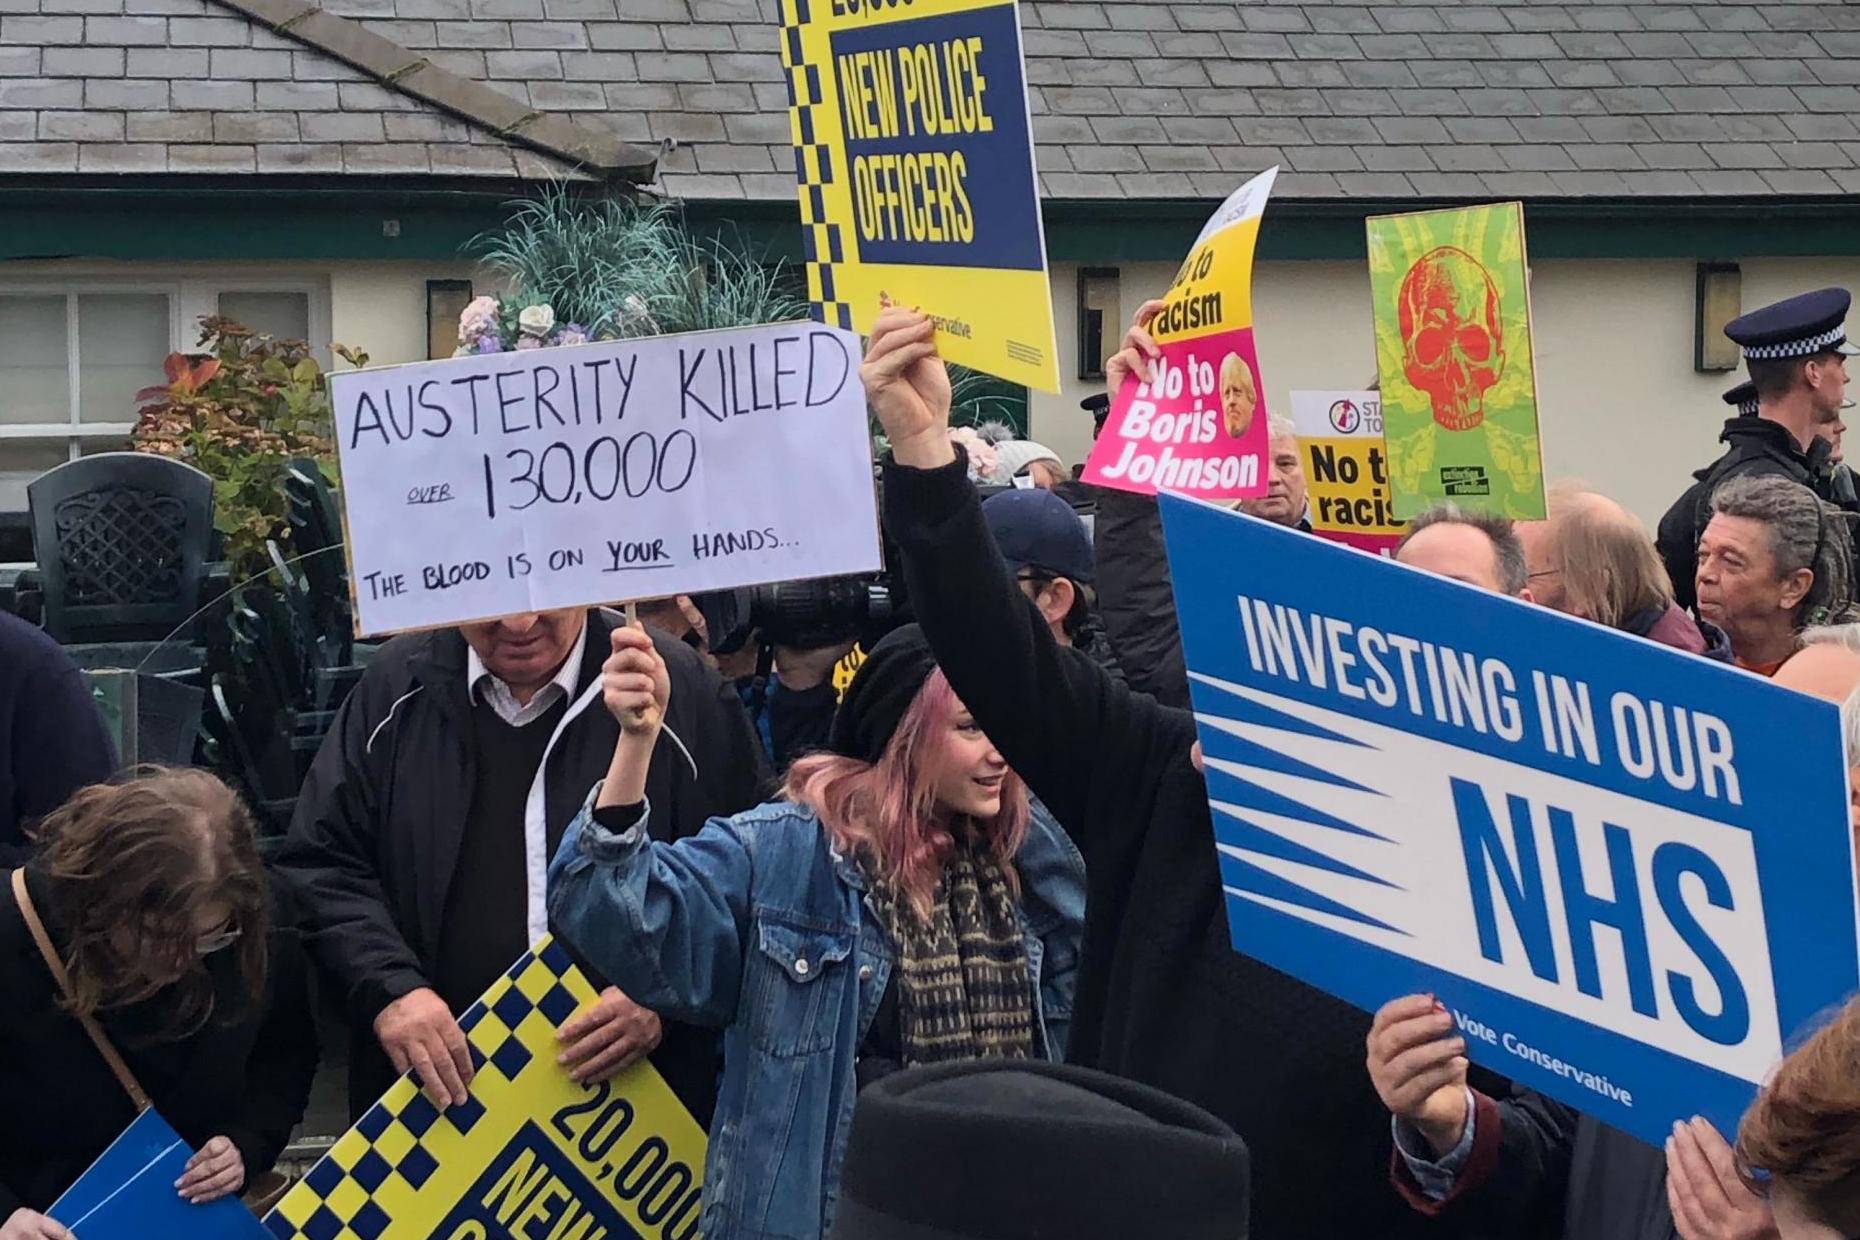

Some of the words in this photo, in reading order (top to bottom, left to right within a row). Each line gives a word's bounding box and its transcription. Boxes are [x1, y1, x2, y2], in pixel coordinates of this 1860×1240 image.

[839, 48, 899, 140] NEW
[898, 36, 994, 136] POLICE
[853, 150, 975, 244] OFFICERS
[1191, 245, 1214, 282] to
[351, 353, 638, 449] AUSTERITY
[679, 331, 850, 423] KILLED
[1135, 355, 1183, 400] No
[1187, 352, 1215, 398] to
[1101, 441, 1258, 490] Johnson
[1118, 399, 1217, 444] Boris
[1310, 445, 1359, 484] No
[1368, 448, 1387, 484] t
[407, 483, 453, 503] OVER
[483, 429, 697, 519] 130,000
[364, 570, 408, 600] THE
[423, 562, 490, 590] BLOOD
[507, 554, 533, 579] IS
[549, 549, 584, 570] ON
[607, 539, 670, 570] YOUR
[693, 528, 801, 560] HANDS...
[1237, 595, 1523, 743] INVESTING
[1532, 670, 1601, 766] IN
[1611, 692, 1743, 806] OUR
[1449, 775, 1751, 1047] NHS
[1453, 1008, 1498, 1046] Vote
[1502, 1033, 1633, 1108] Conservative
